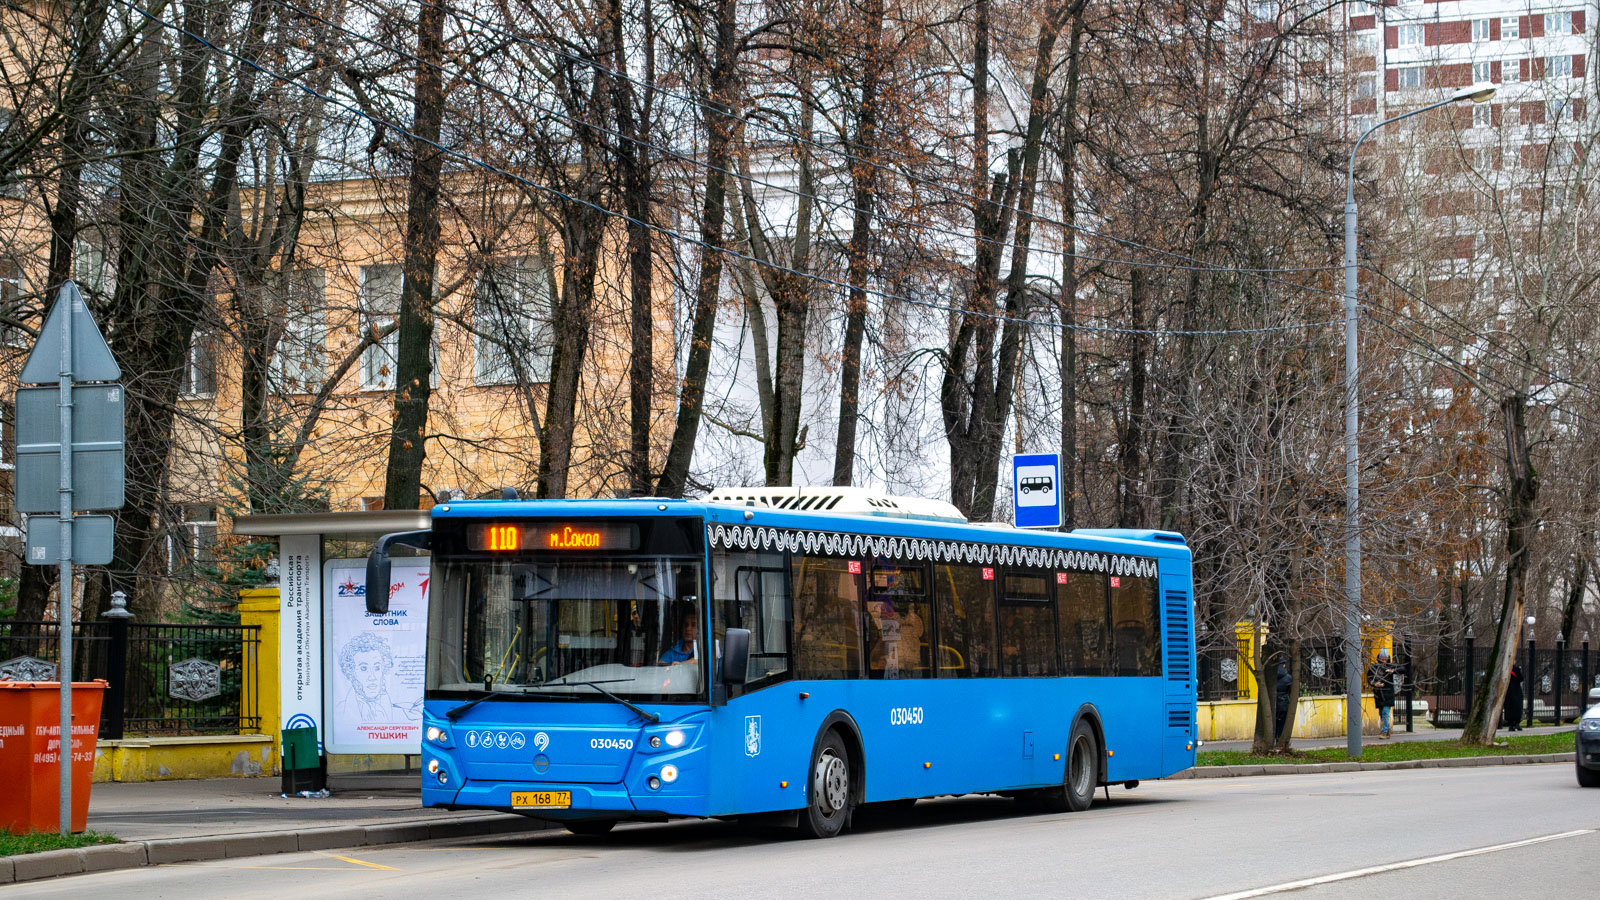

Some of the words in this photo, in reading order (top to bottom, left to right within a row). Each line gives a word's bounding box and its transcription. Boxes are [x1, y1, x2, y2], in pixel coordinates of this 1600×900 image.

[490, 527, 517, 550] 110
[550, 527, 600, 547] м.Сокол
[891, 706, 924, 726] 030450
[590, 738, 633, 749] 030450
[34, 752, 56, 763] 8(495)
[533, 794, 551, 804] 168
[557, 793, 567, 801] 77
